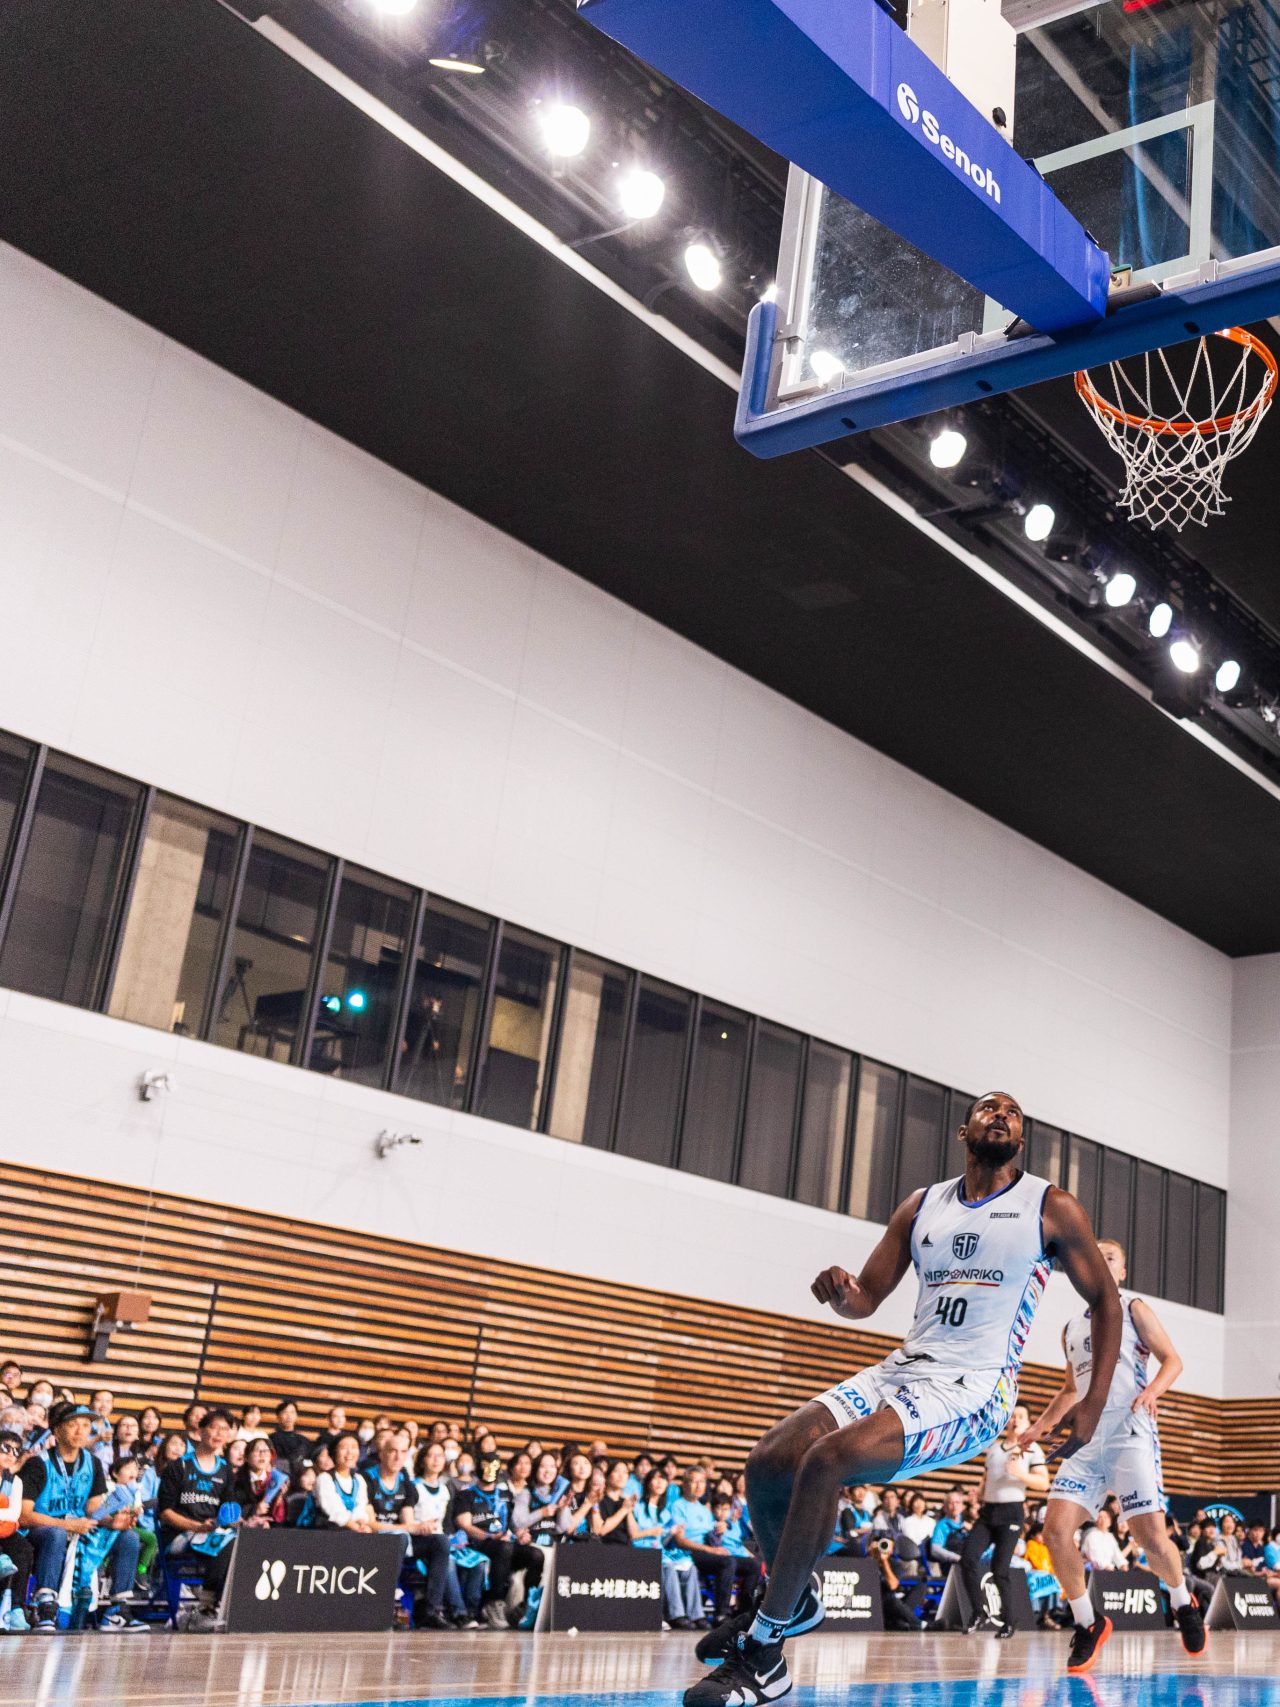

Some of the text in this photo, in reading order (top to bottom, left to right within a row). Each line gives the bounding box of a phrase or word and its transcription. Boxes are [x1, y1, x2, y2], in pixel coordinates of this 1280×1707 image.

[921, 109, 1001, 205] Senoh
[935, 1296, 968, 1328] 40
[292, 1564, 379, 1595] TRICK
[1123, 1588, 1158, 1614] HIS
